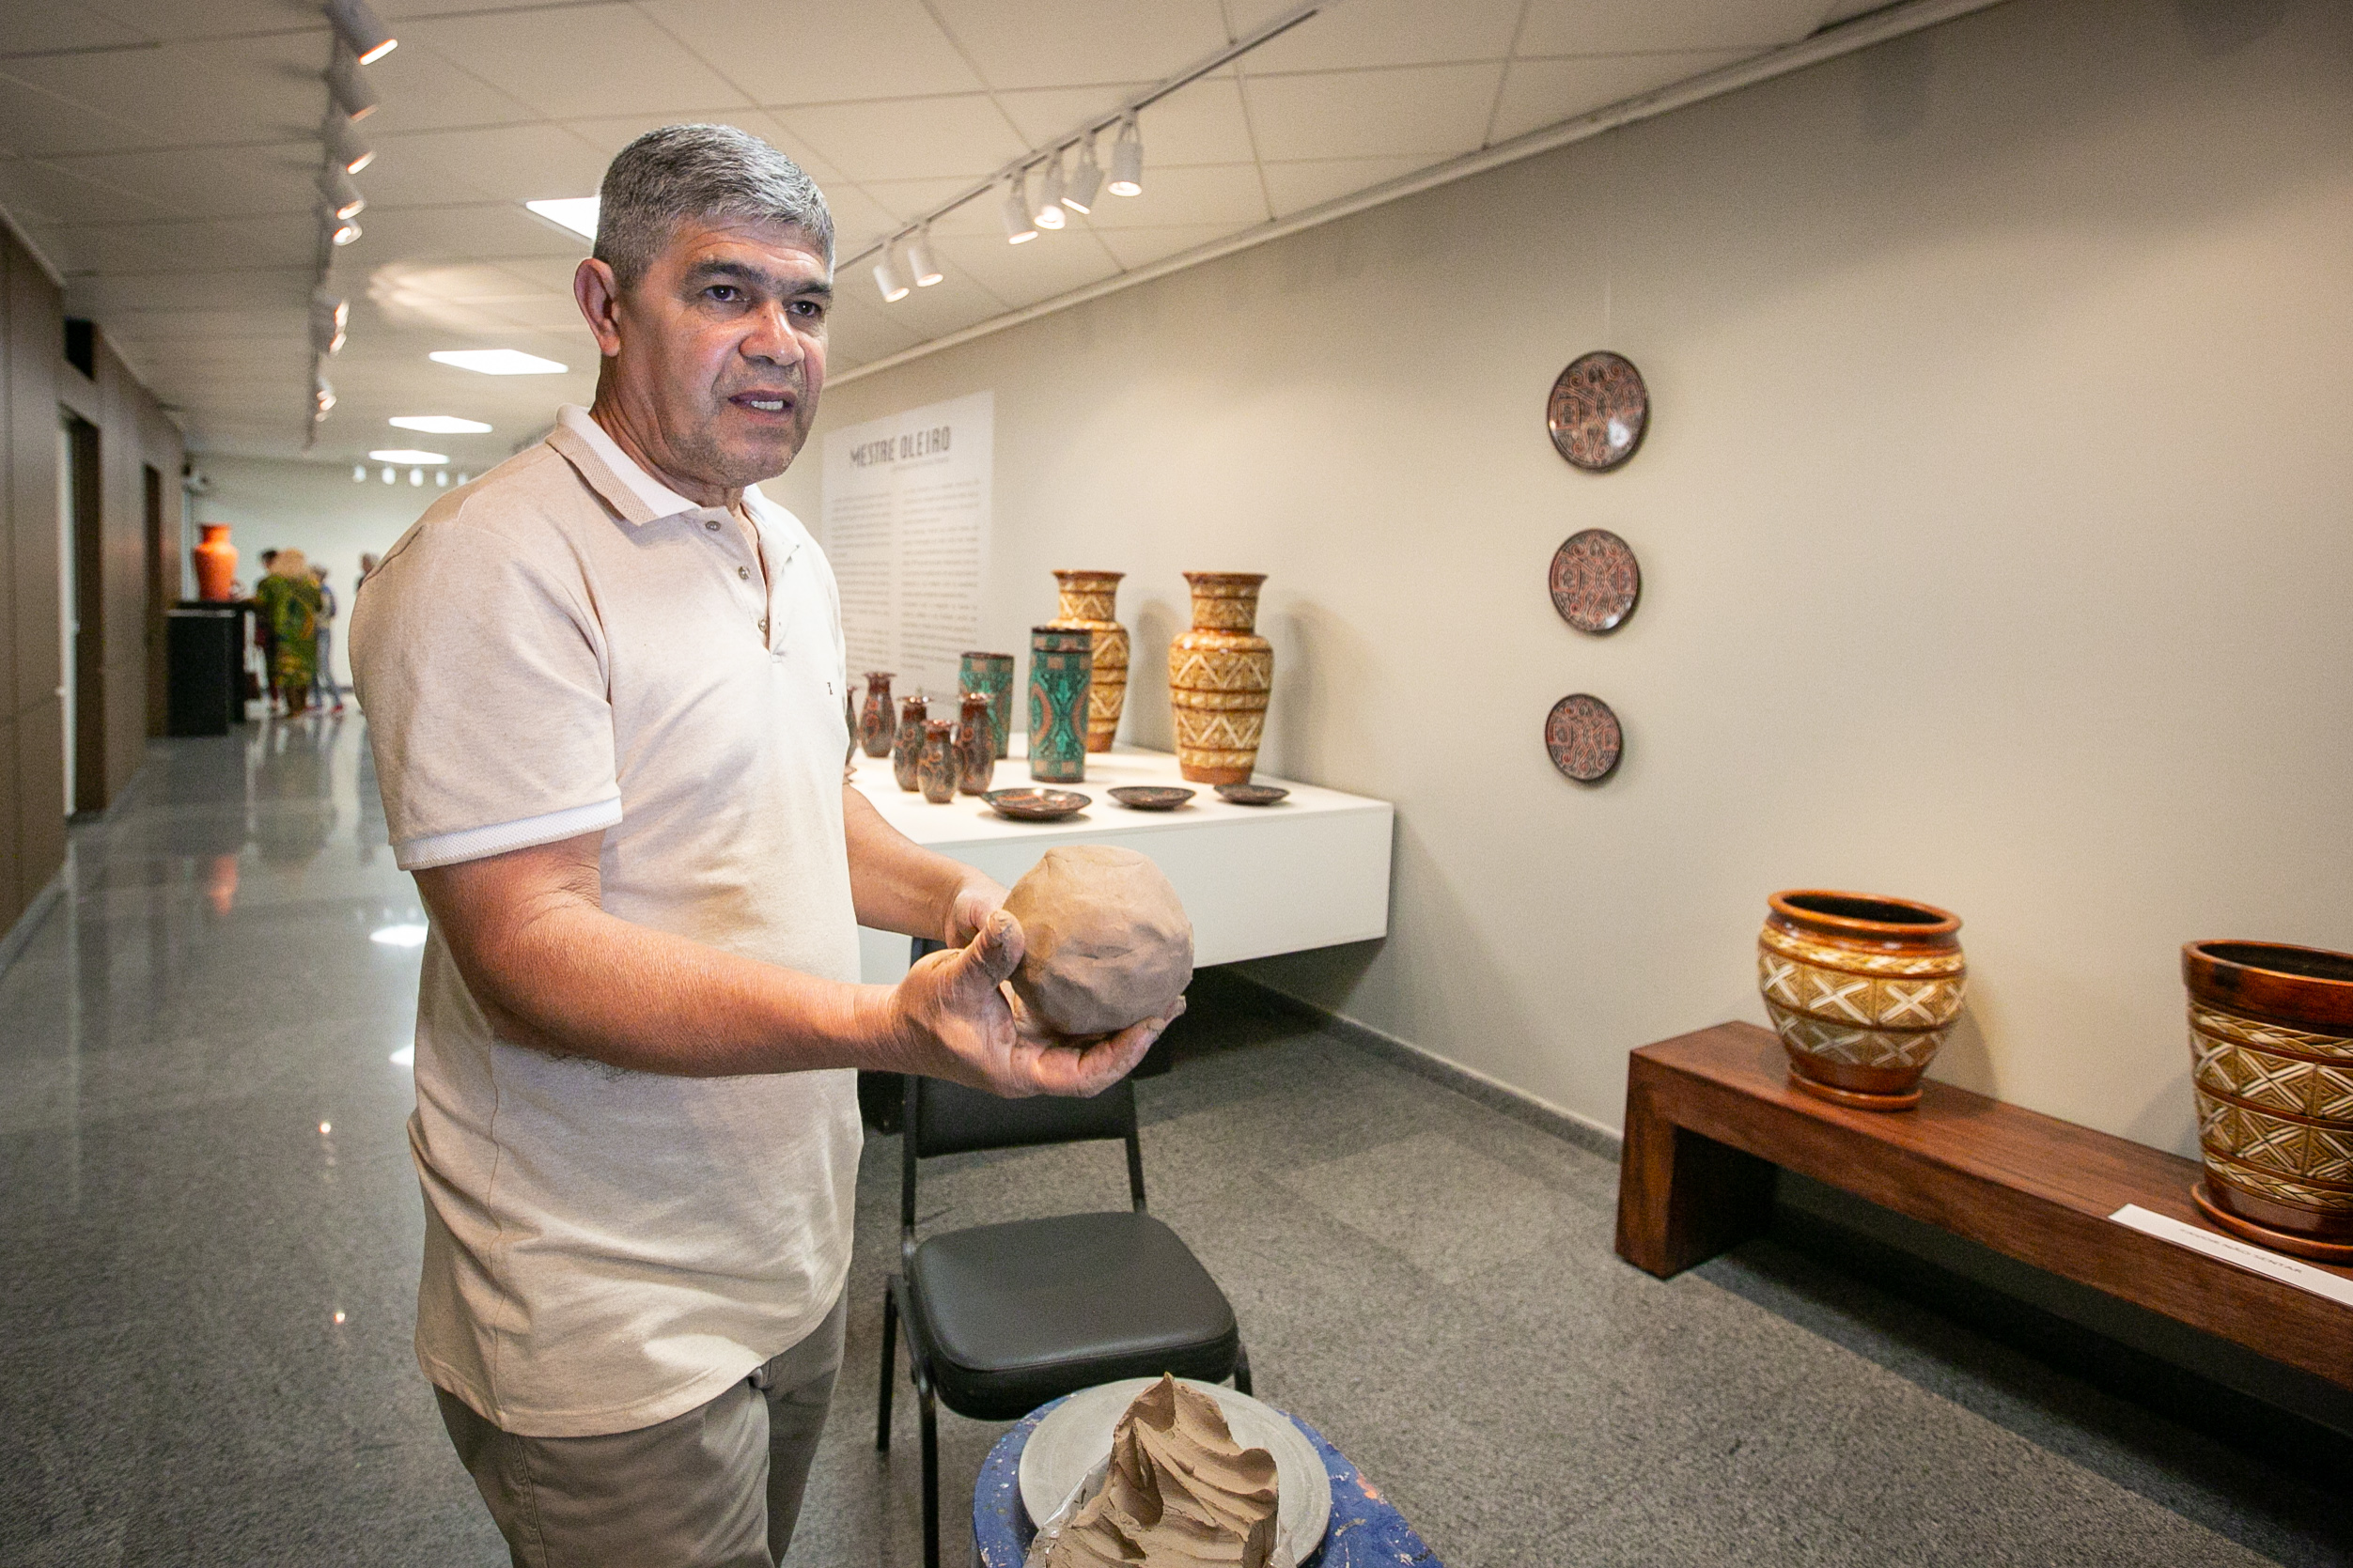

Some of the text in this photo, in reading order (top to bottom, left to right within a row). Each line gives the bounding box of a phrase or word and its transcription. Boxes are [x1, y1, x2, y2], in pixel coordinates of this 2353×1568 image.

[849, 437, 895, 468] MESTRE
[899, 426, 951, 459] OLEIRO
[2254, 1254, 2302, 1274] SENTAR
